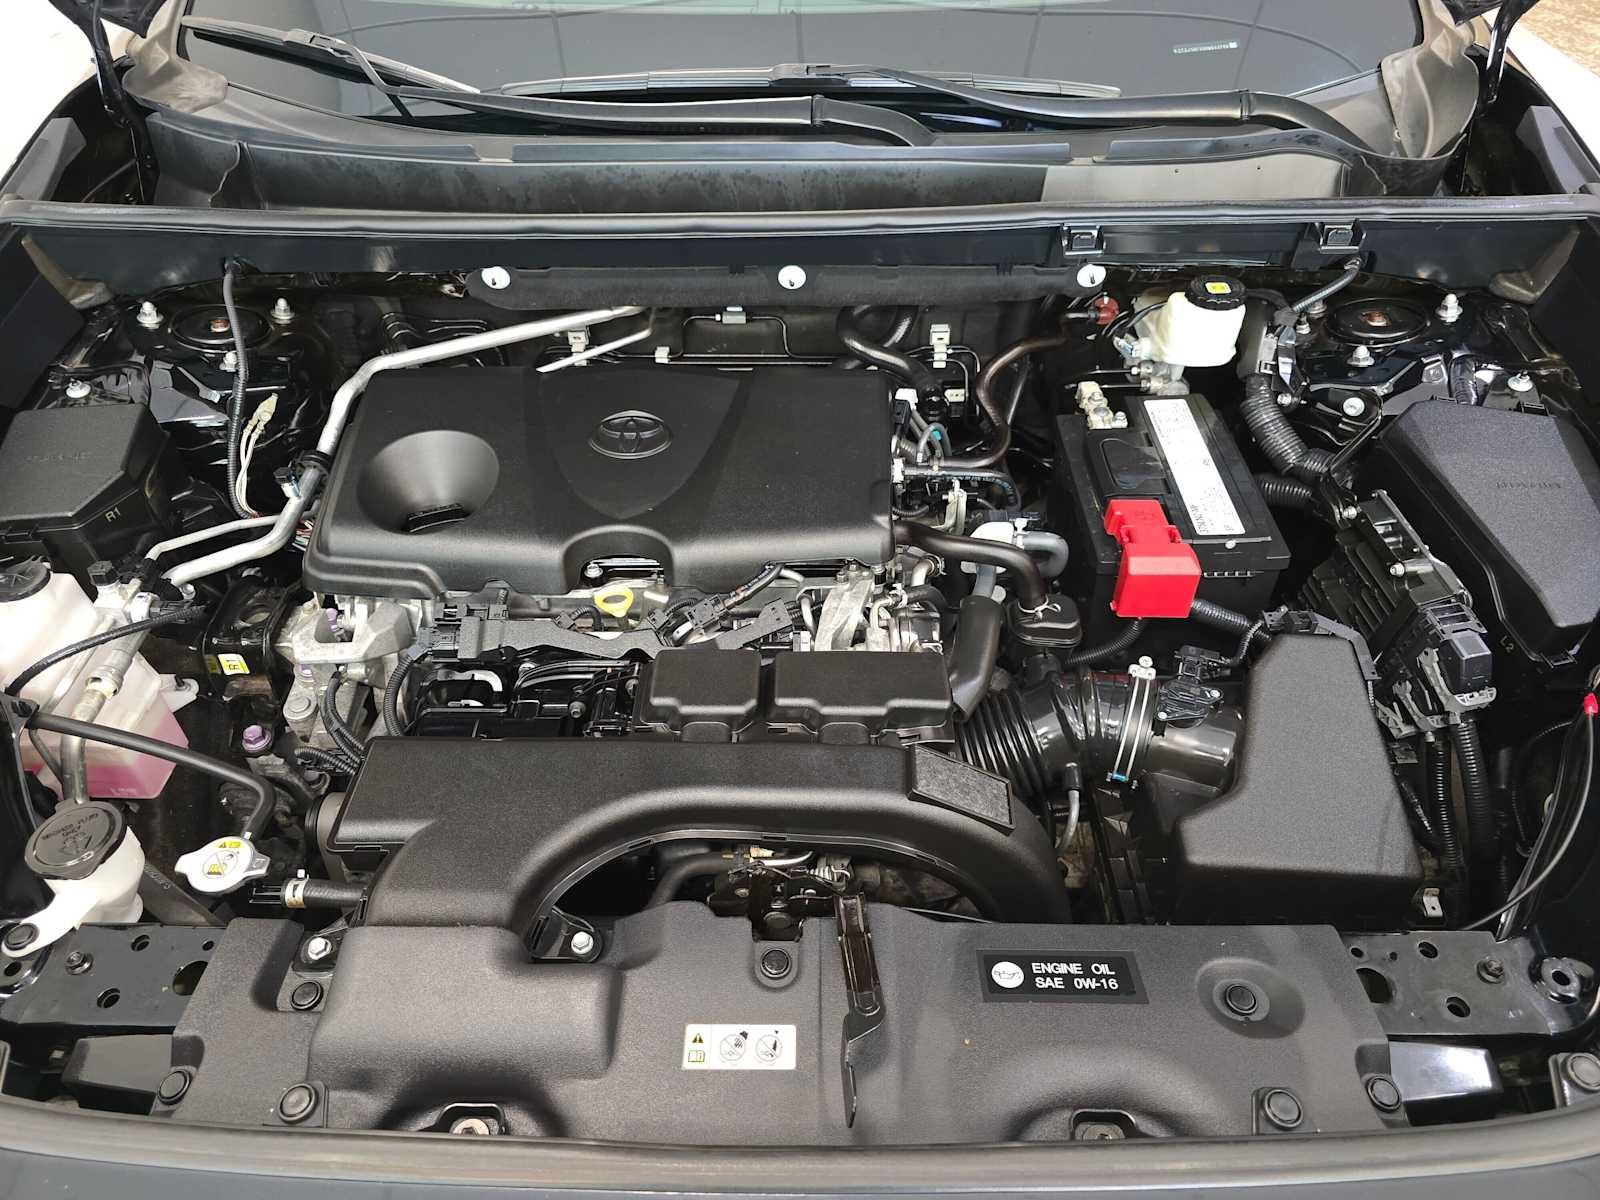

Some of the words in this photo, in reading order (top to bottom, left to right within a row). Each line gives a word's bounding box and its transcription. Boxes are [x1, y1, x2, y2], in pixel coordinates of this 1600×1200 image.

[105, 507, 121, 522] R1
[1500, 635, 1514, 653] L2
[1031, 962, 1083, 975] ENGINE
[1091, 963, 1115, 975] OIL
[1035, 977, 1065, 989] SAE
[1074, 978, 1119, 990] 0W-16
